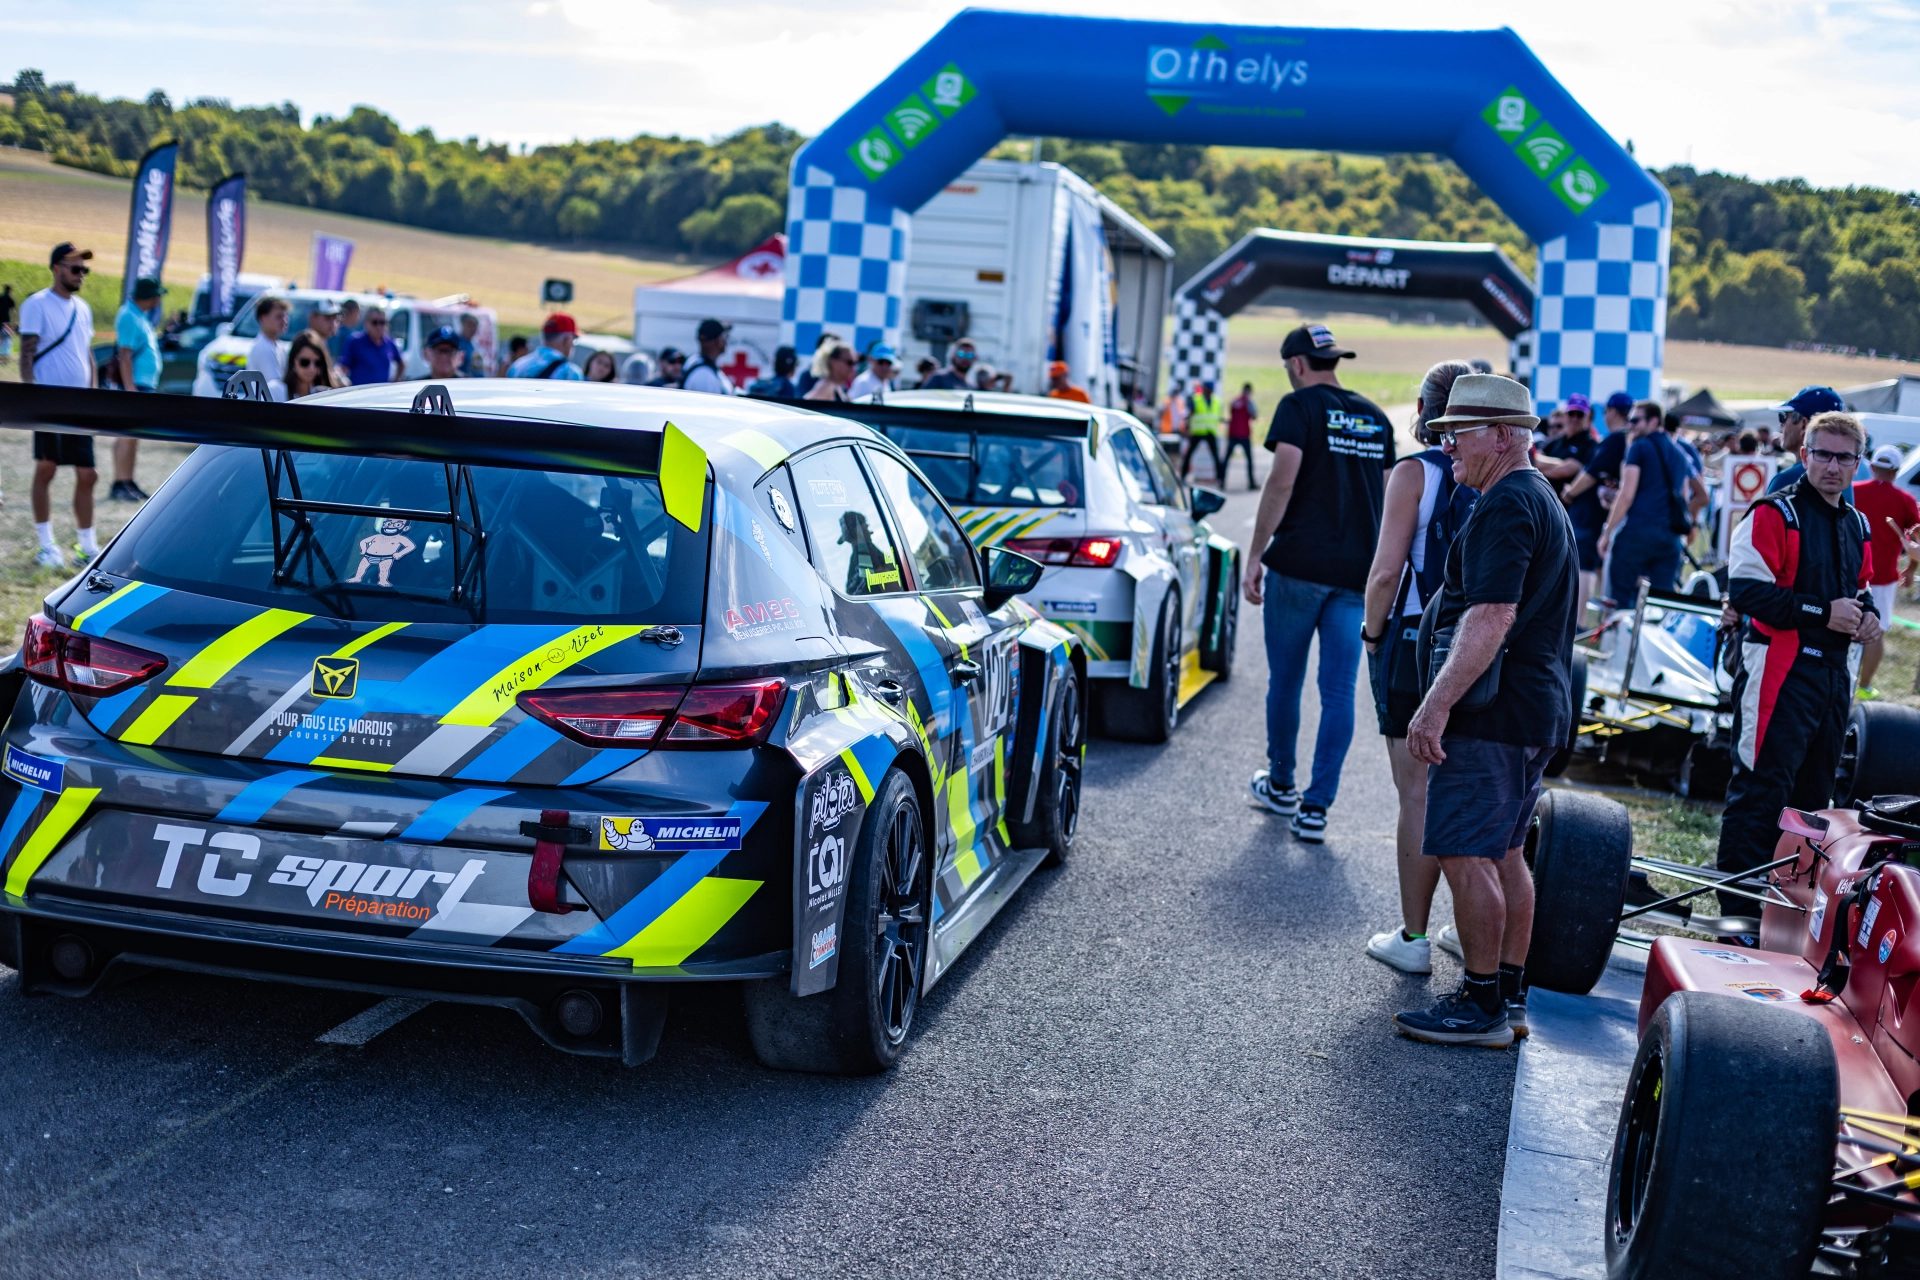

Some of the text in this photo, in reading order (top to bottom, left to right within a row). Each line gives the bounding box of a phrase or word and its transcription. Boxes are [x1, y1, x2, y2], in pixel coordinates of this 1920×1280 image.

[1150, 48, 1309, 92] Othelys
[137, 168, 166, 277] mplitude
[1327, 262, 1410, 289] DÉPART
[726, 597, 799, 633] AM2C
[492, 662, 541, 702] Maison
[269, 728, 391, 747] DE COURSE DE COTE
[270, 711, 393, 737] POUR TOUS LES MORDUS
[11, 758, 51, 781] MICHELIN
[656, 826, 741, 839] MICHELIN
[152, 823, 487, 921] TC sport
[324, 892, 430, 920] Préparation
[808, 885, 843, 908] Nicolas MILLET
